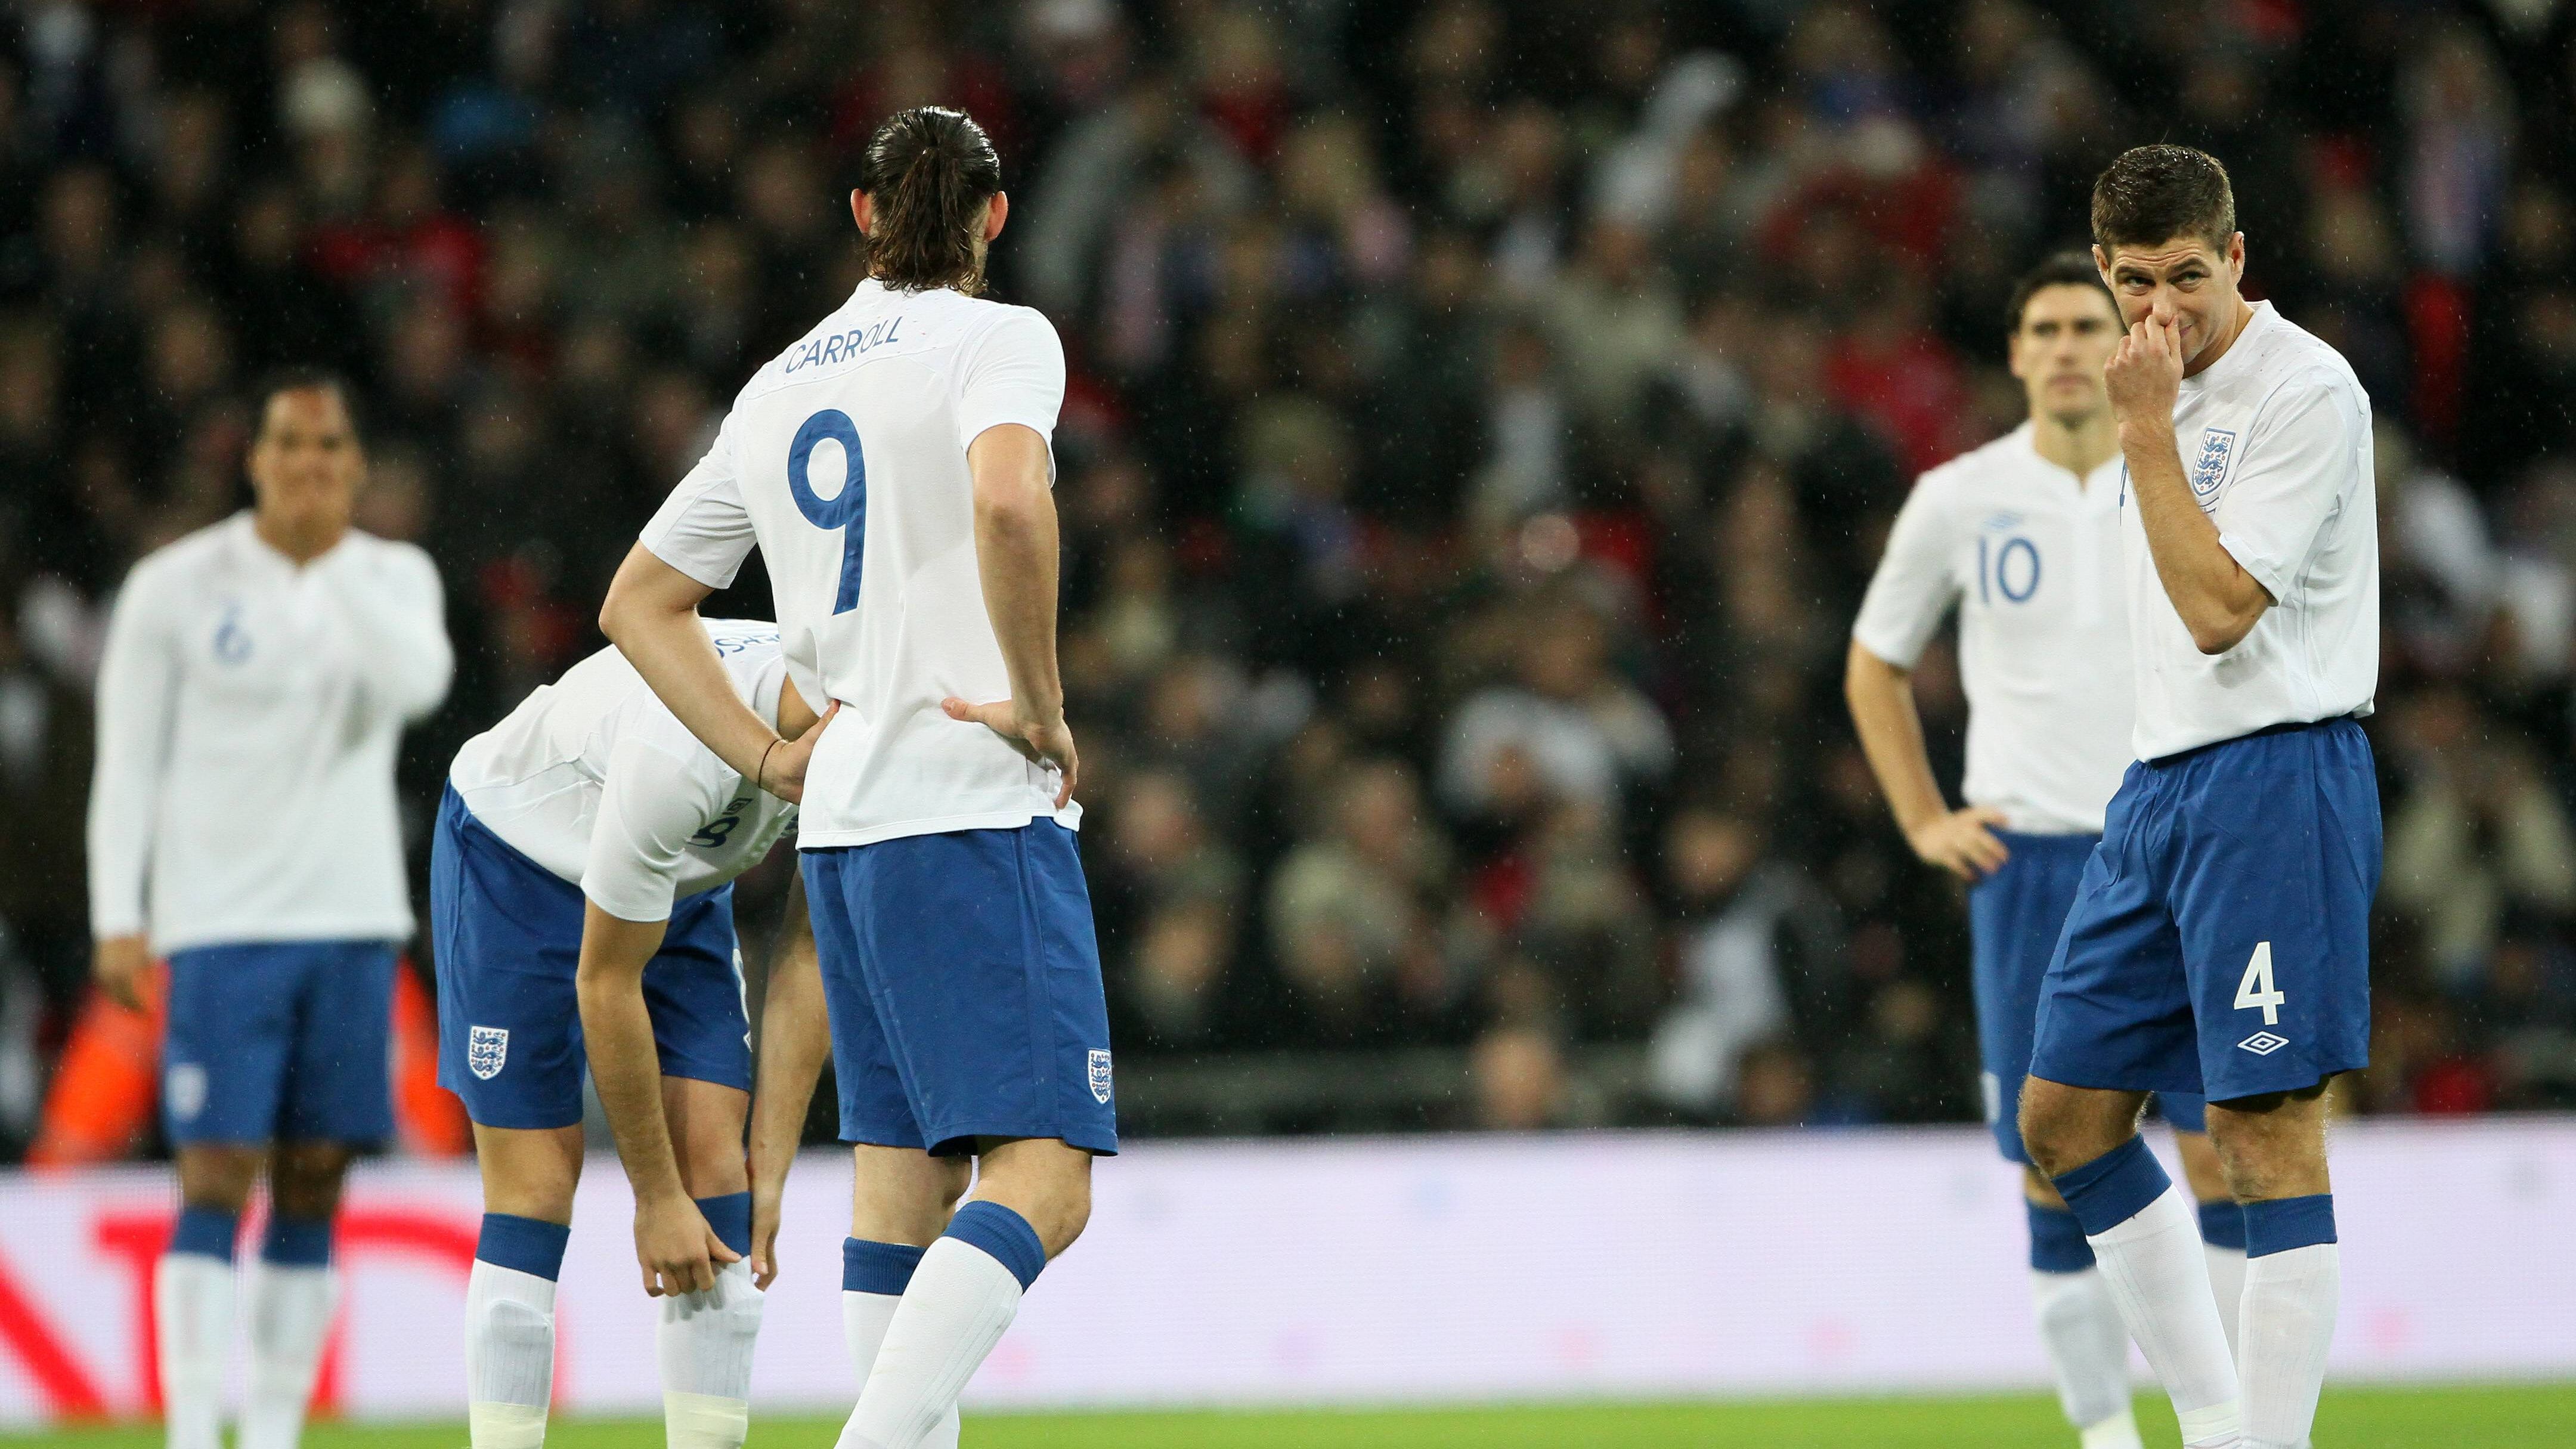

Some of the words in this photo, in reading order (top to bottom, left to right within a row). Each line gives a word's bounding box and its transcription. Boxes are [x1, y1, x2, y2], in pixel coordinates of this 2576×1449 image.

[785, 316, 903, 374] CARROLL
[787, 408, 867, 616] 9
[1978, 536, 2041, 606] 10
[2233, 940, 2286, 1026] 4
